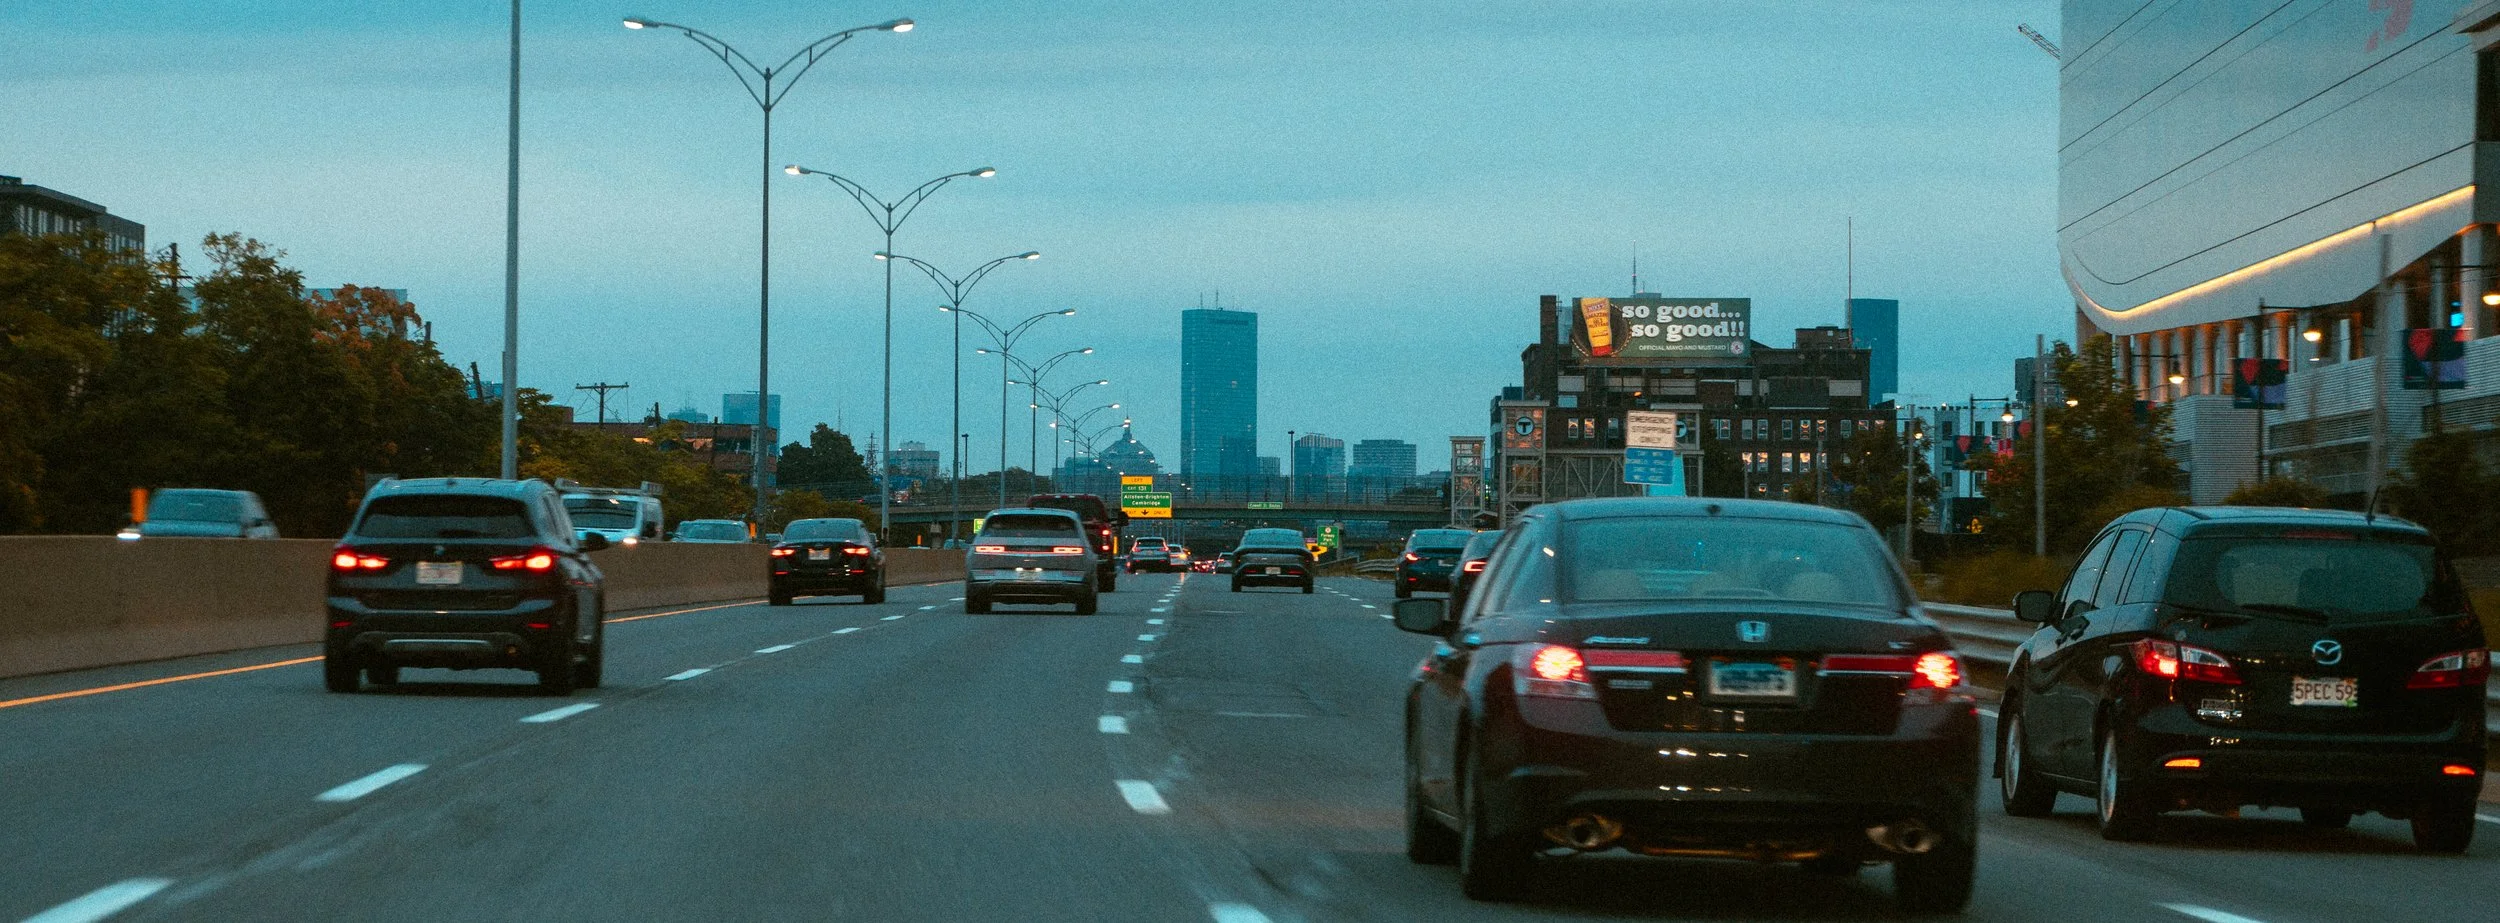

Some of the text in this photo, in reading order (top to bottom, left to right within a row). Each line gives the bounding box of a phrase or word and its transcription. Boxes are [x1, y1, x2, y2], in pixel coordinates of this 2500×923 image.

[1622, 303, 1741, 322] so good...
[1631, 321, 1745, 342] so good!!
[1630, 415, 1673, 424] EMERGENCY
[1631, 425, 1672, 434] STOPPING
[1639, 436, 1661, 444] ONLY
[2295, 683, 2353, 701] 5PEC 59
